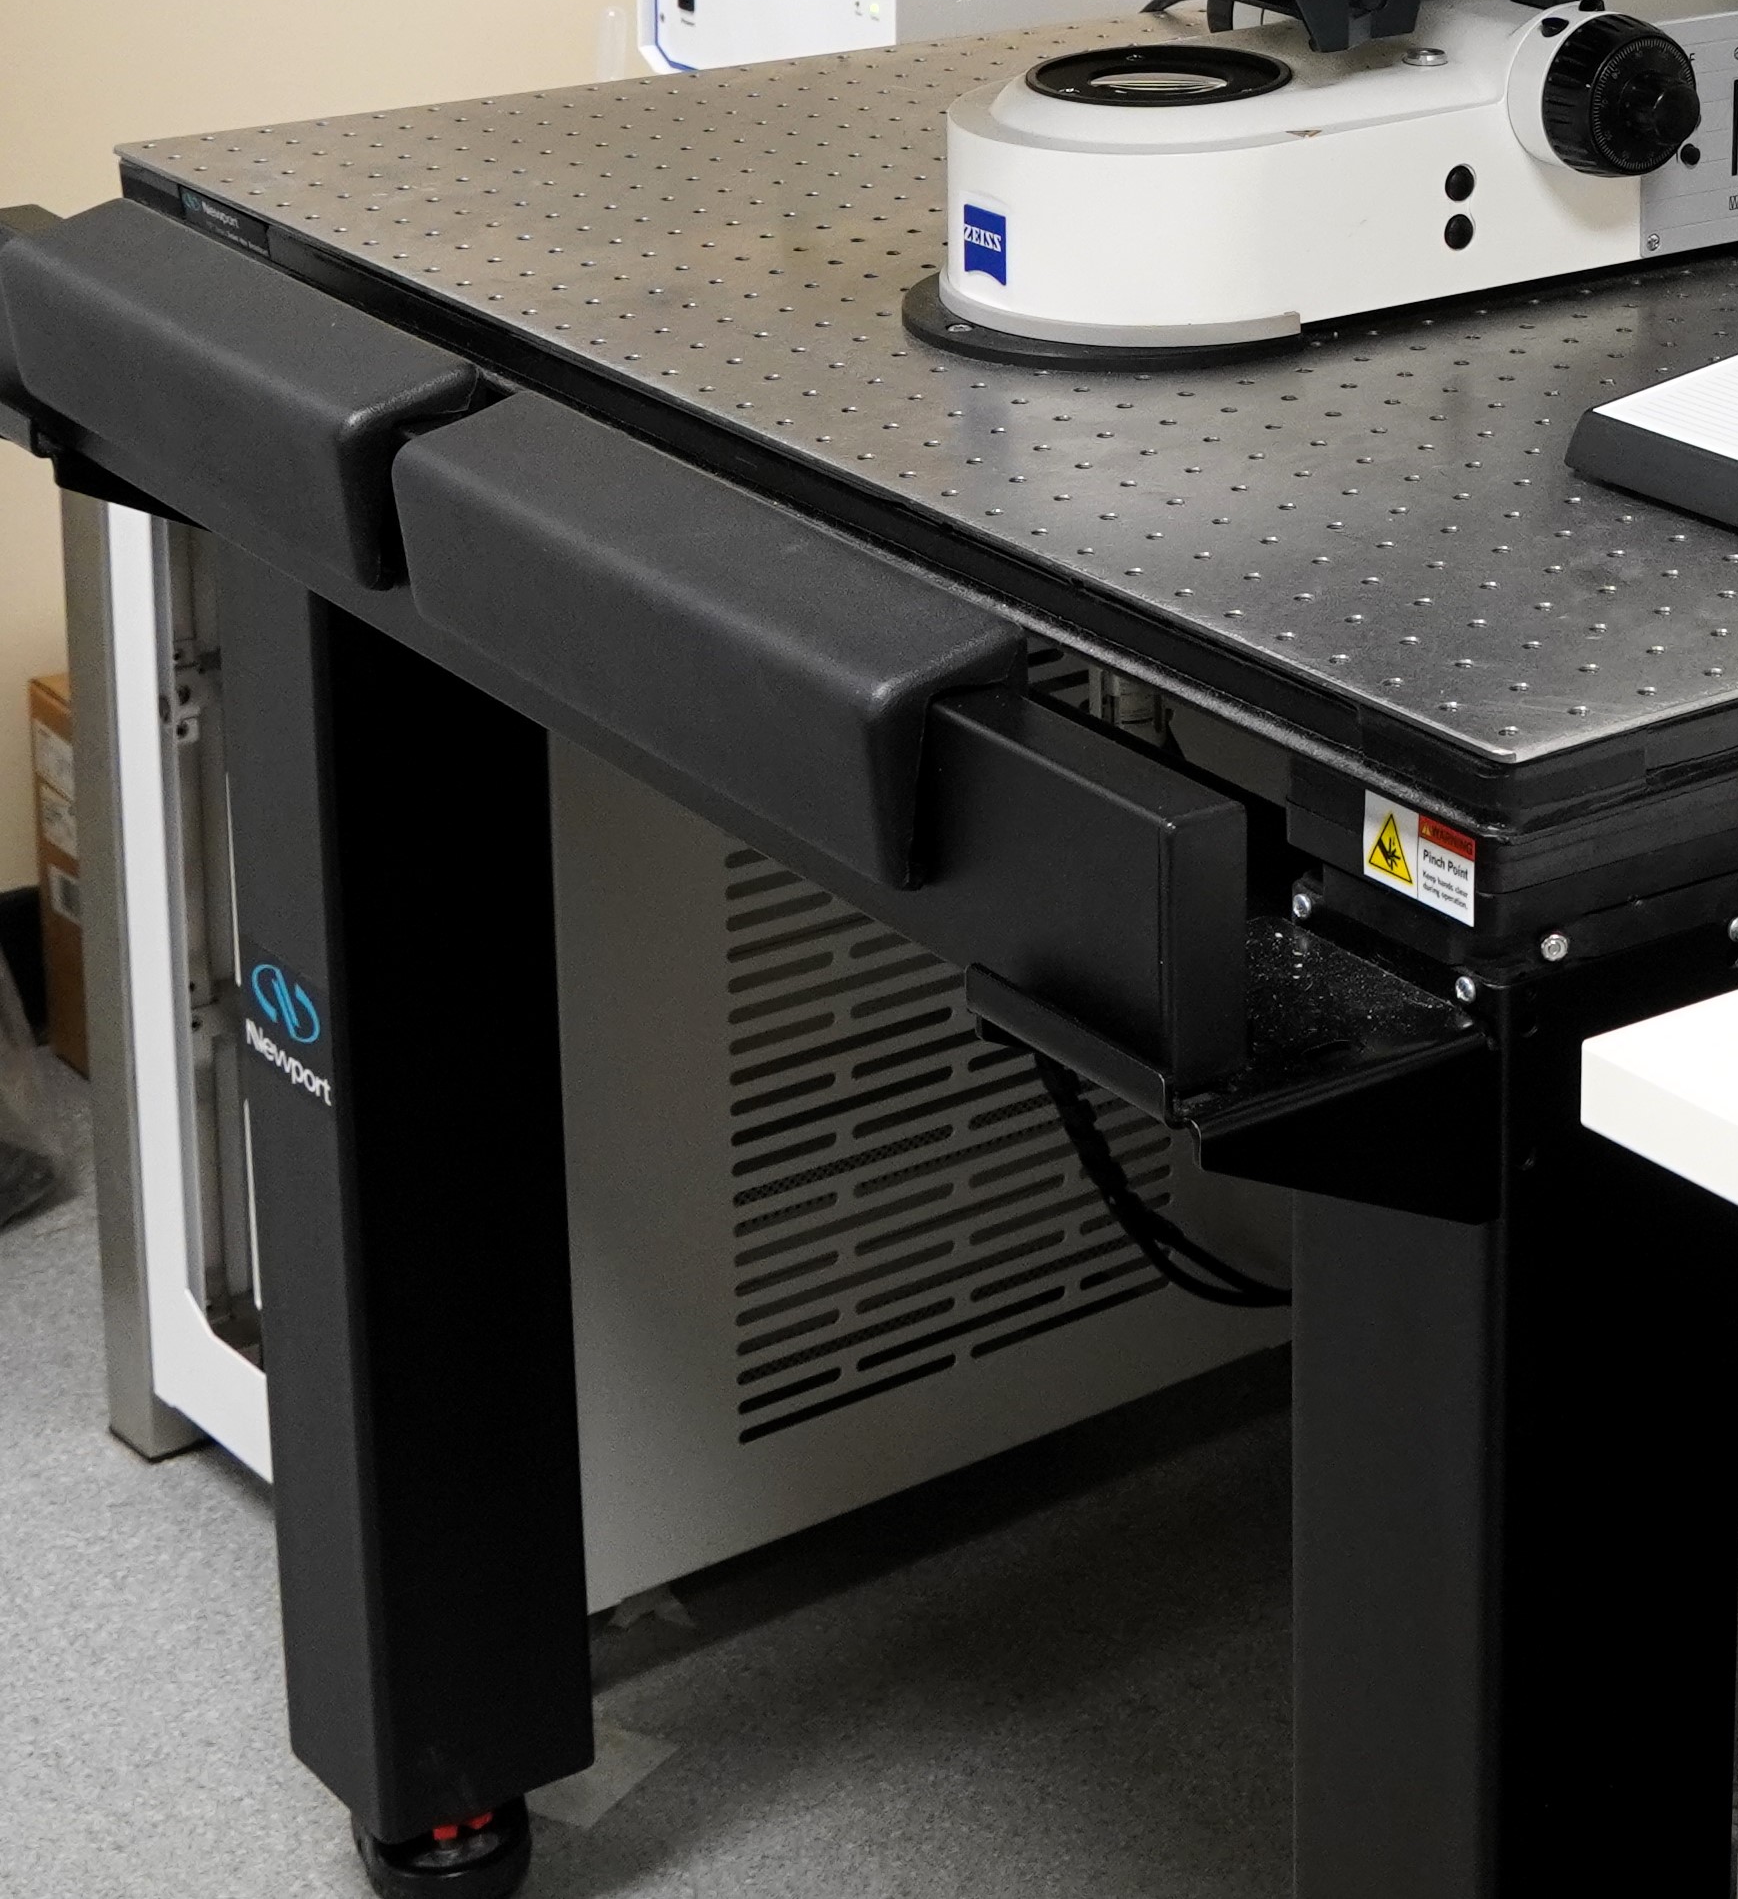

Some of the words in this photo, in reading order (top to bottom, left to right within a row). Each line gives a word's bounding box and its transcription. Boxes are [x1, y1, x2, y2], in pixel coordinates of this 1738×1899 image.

[964, 223, 1002, 253] ZEISS
[1430, 826, 1473, 855] WARNING
[1423, 849, 1446, 870] Pinch
[1447, 859, 1469, 881] Point
[1422, 869, 1436, 884] Keep
[1438, 876, 1454, 892] hands
[1455, 883, 1469, 899] clear
[1422, 882, 1441, 899] during
[245, 1018, 332, 1106] Newport
